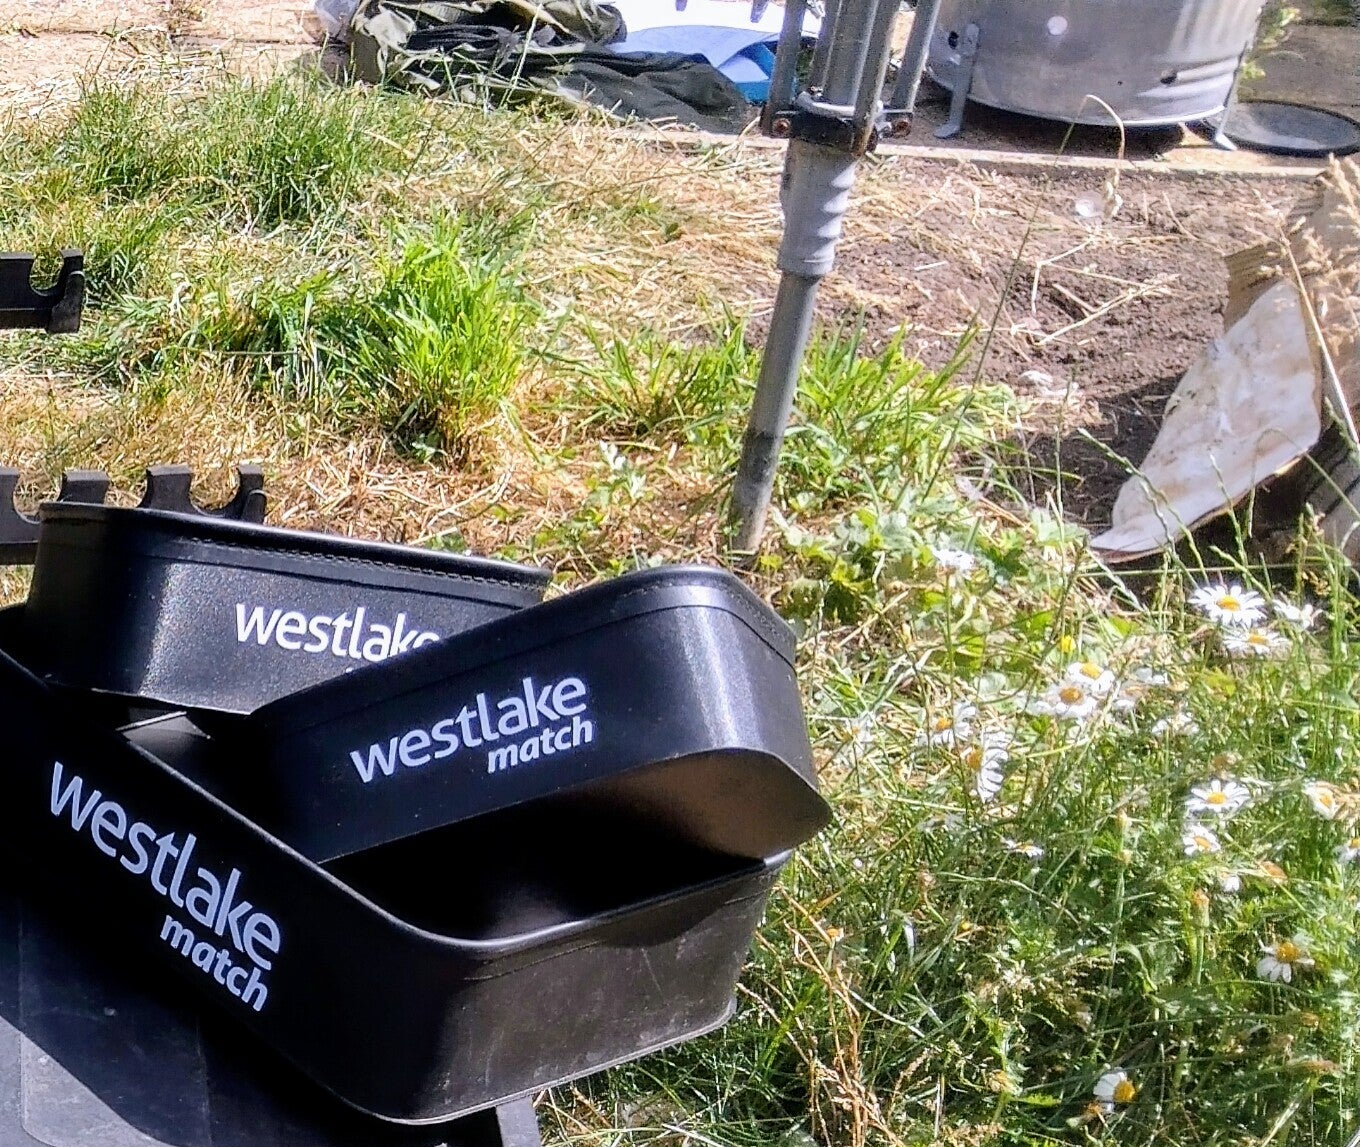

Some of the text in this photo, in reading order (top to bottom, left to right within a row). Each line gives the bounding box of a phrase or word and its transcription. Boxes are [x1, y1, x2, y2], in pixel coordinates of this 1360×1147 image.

[350, 676, 587, 783] westlake
[487, 716, 593, 774] match
[51, 761, 281, 971] westlake
[160, 915, 268, 1012] match
